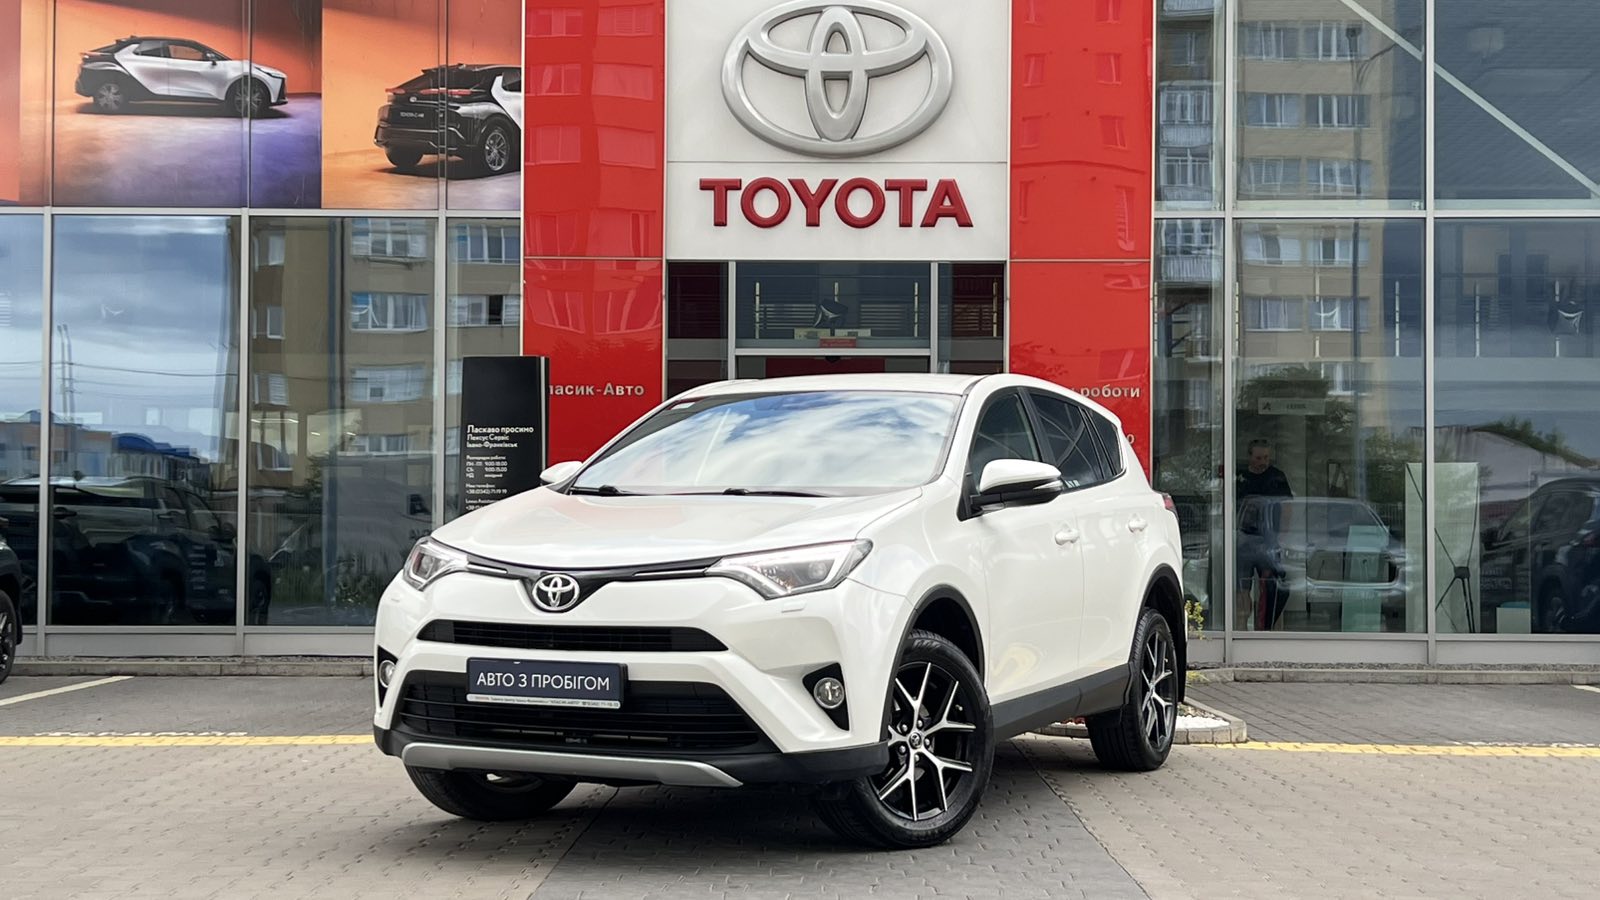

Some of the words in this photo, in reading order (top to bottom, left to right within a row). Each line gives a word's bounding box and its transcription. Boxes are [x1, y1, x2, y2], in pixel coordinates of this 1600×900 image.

[699, 177, 974, 229] TOYOTA
[1080, 383, 1140, 398] роботи
[466, 424, 500, 433] Ласкаво
[500, 426, 534, 435] просимо
[489, 433, 510, 441] Сервіс
[476, 672, 515, 687] АВТО
[518, 673, 528, 688] З
[531, 674, 610, 691] ПРОБІГОМ
